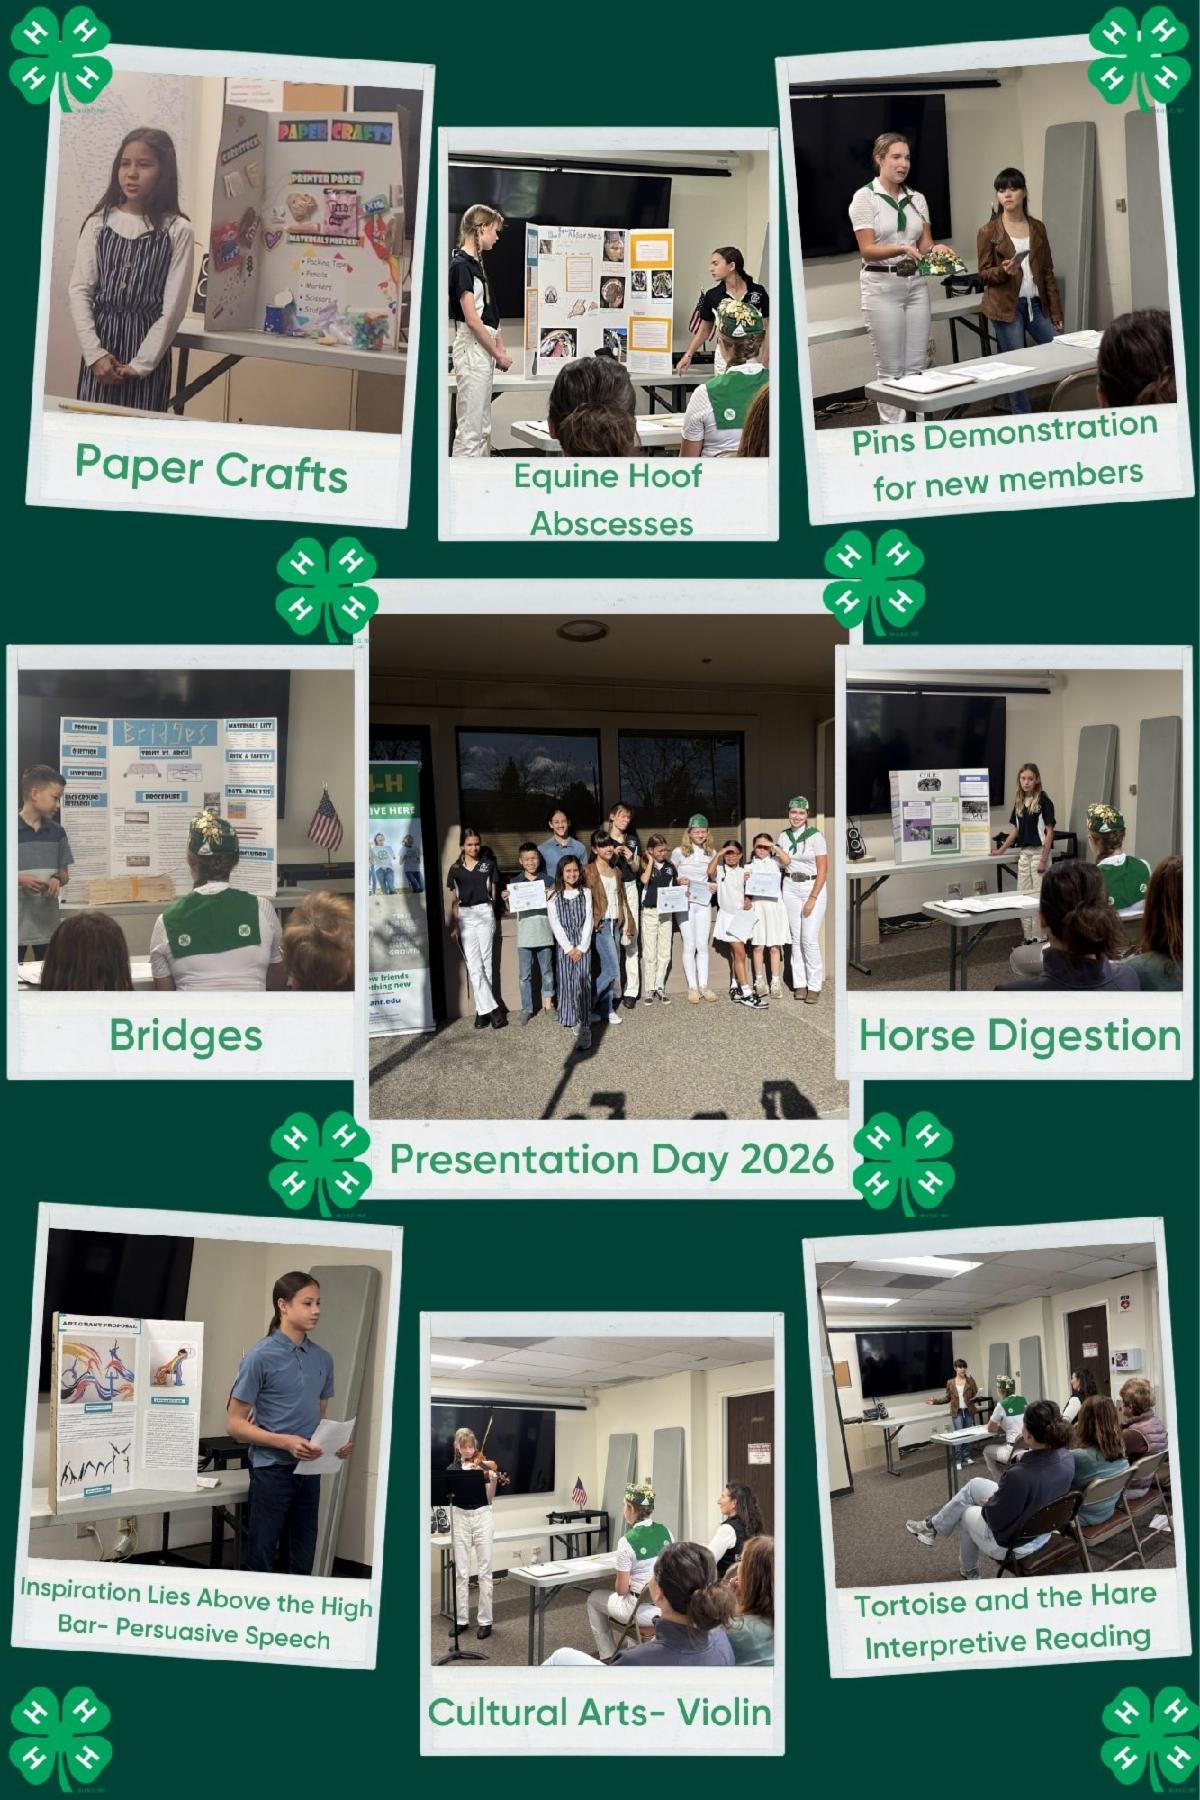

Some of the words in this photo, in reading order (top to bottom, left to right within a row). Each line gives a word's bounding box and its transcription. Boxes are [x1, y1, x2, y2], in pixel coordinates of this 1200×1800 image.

[279, 122, 327, 140] PAPER
[332, 122, 391, 143] CRAFTS
[292, 174, 329, 184] PRINTER
[330, 174, 361, 184] PAPER
[123, 719, 209, 745] Bridges
[389, 806, 416, 814] HERE
[381, 972, 409, 981] friends
[394, 981, 411, 989] new
